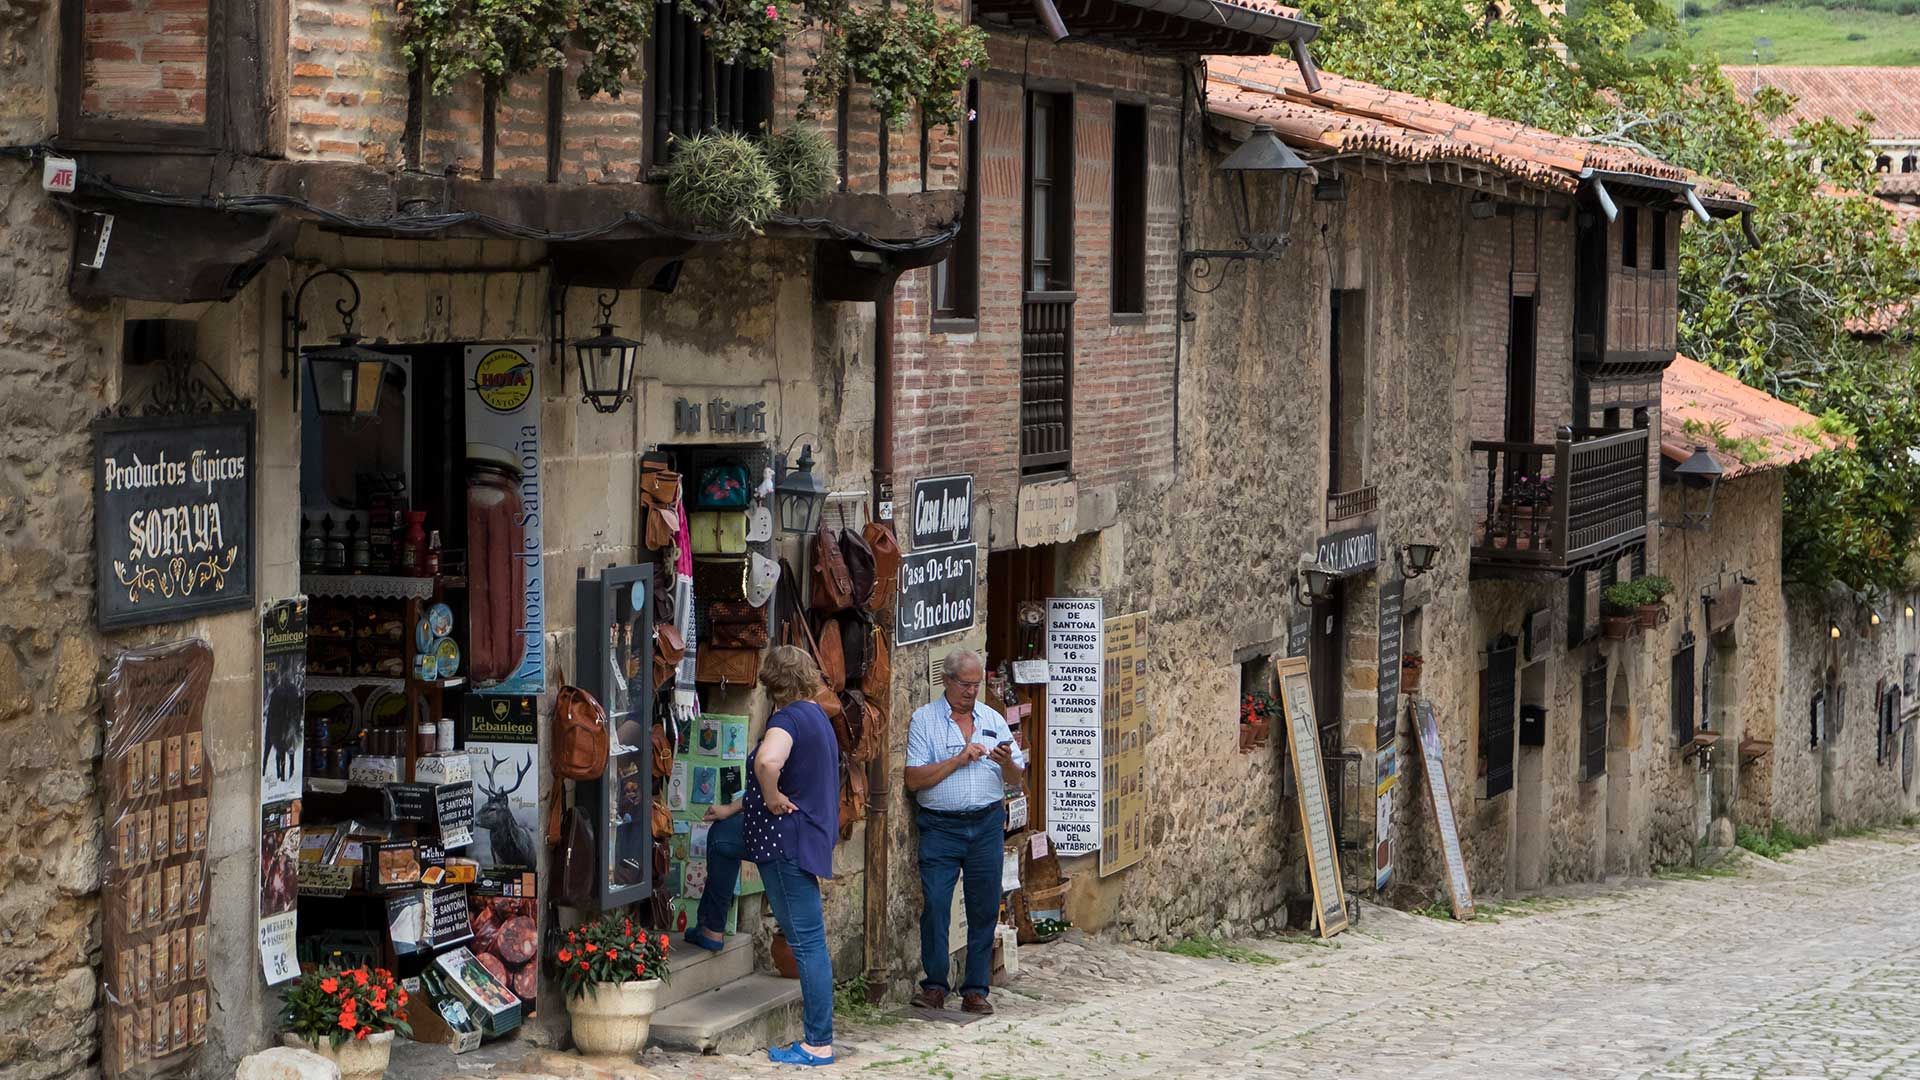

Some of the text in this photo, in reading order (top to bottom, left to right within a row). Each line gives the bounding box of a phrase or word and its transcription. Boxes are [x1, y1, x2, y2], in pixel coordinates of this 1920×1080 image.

[50, 169, 73, 186] ATE
[105, 450, 186, 492] Productos
[915, 481, 971, 543] Casa Angel
[129, 502, 224, 560] SORAYA
[514, 424, 541, 679] Anchoas de Santoña
[1319, 542, 1339, 570] CASA
[902, 556, 964, 594] Casa De Las
[1052, 602, 1096, 610] ANCHOAS
[913, 593, 971, 631] Anchoas
[267, 628, 304, 643] Lebaniego
[1051, 634, 1097, 642] 8 TARROS
[1063, 651, 1077, 660] 16
[1060, 666, 1097, 674] TARROS
[1062, 683, 1077, 692] 20
[1060, 698, 1097, 706] TARROS
[1054, 706, 1094, 714] MEDIANOS
[472, 716, 533, 734] Lebaniego
[1051, 729, 1097, 737] 4 TARROS
[1056, 760, 1092, 768] BONITO
[1060, 770, 1097, 778] TARROS
[1063, 779, 1077, 788] 18
[446, 795, 473, 810] SANTOÑA
[1060, 799, 1097, 807] TARROS
[1056, 824, 1091, 832] ANCHOAS
[1066, 833, 1081, 841] DEL
[440, 898, 466, 915] SANTOÑA
